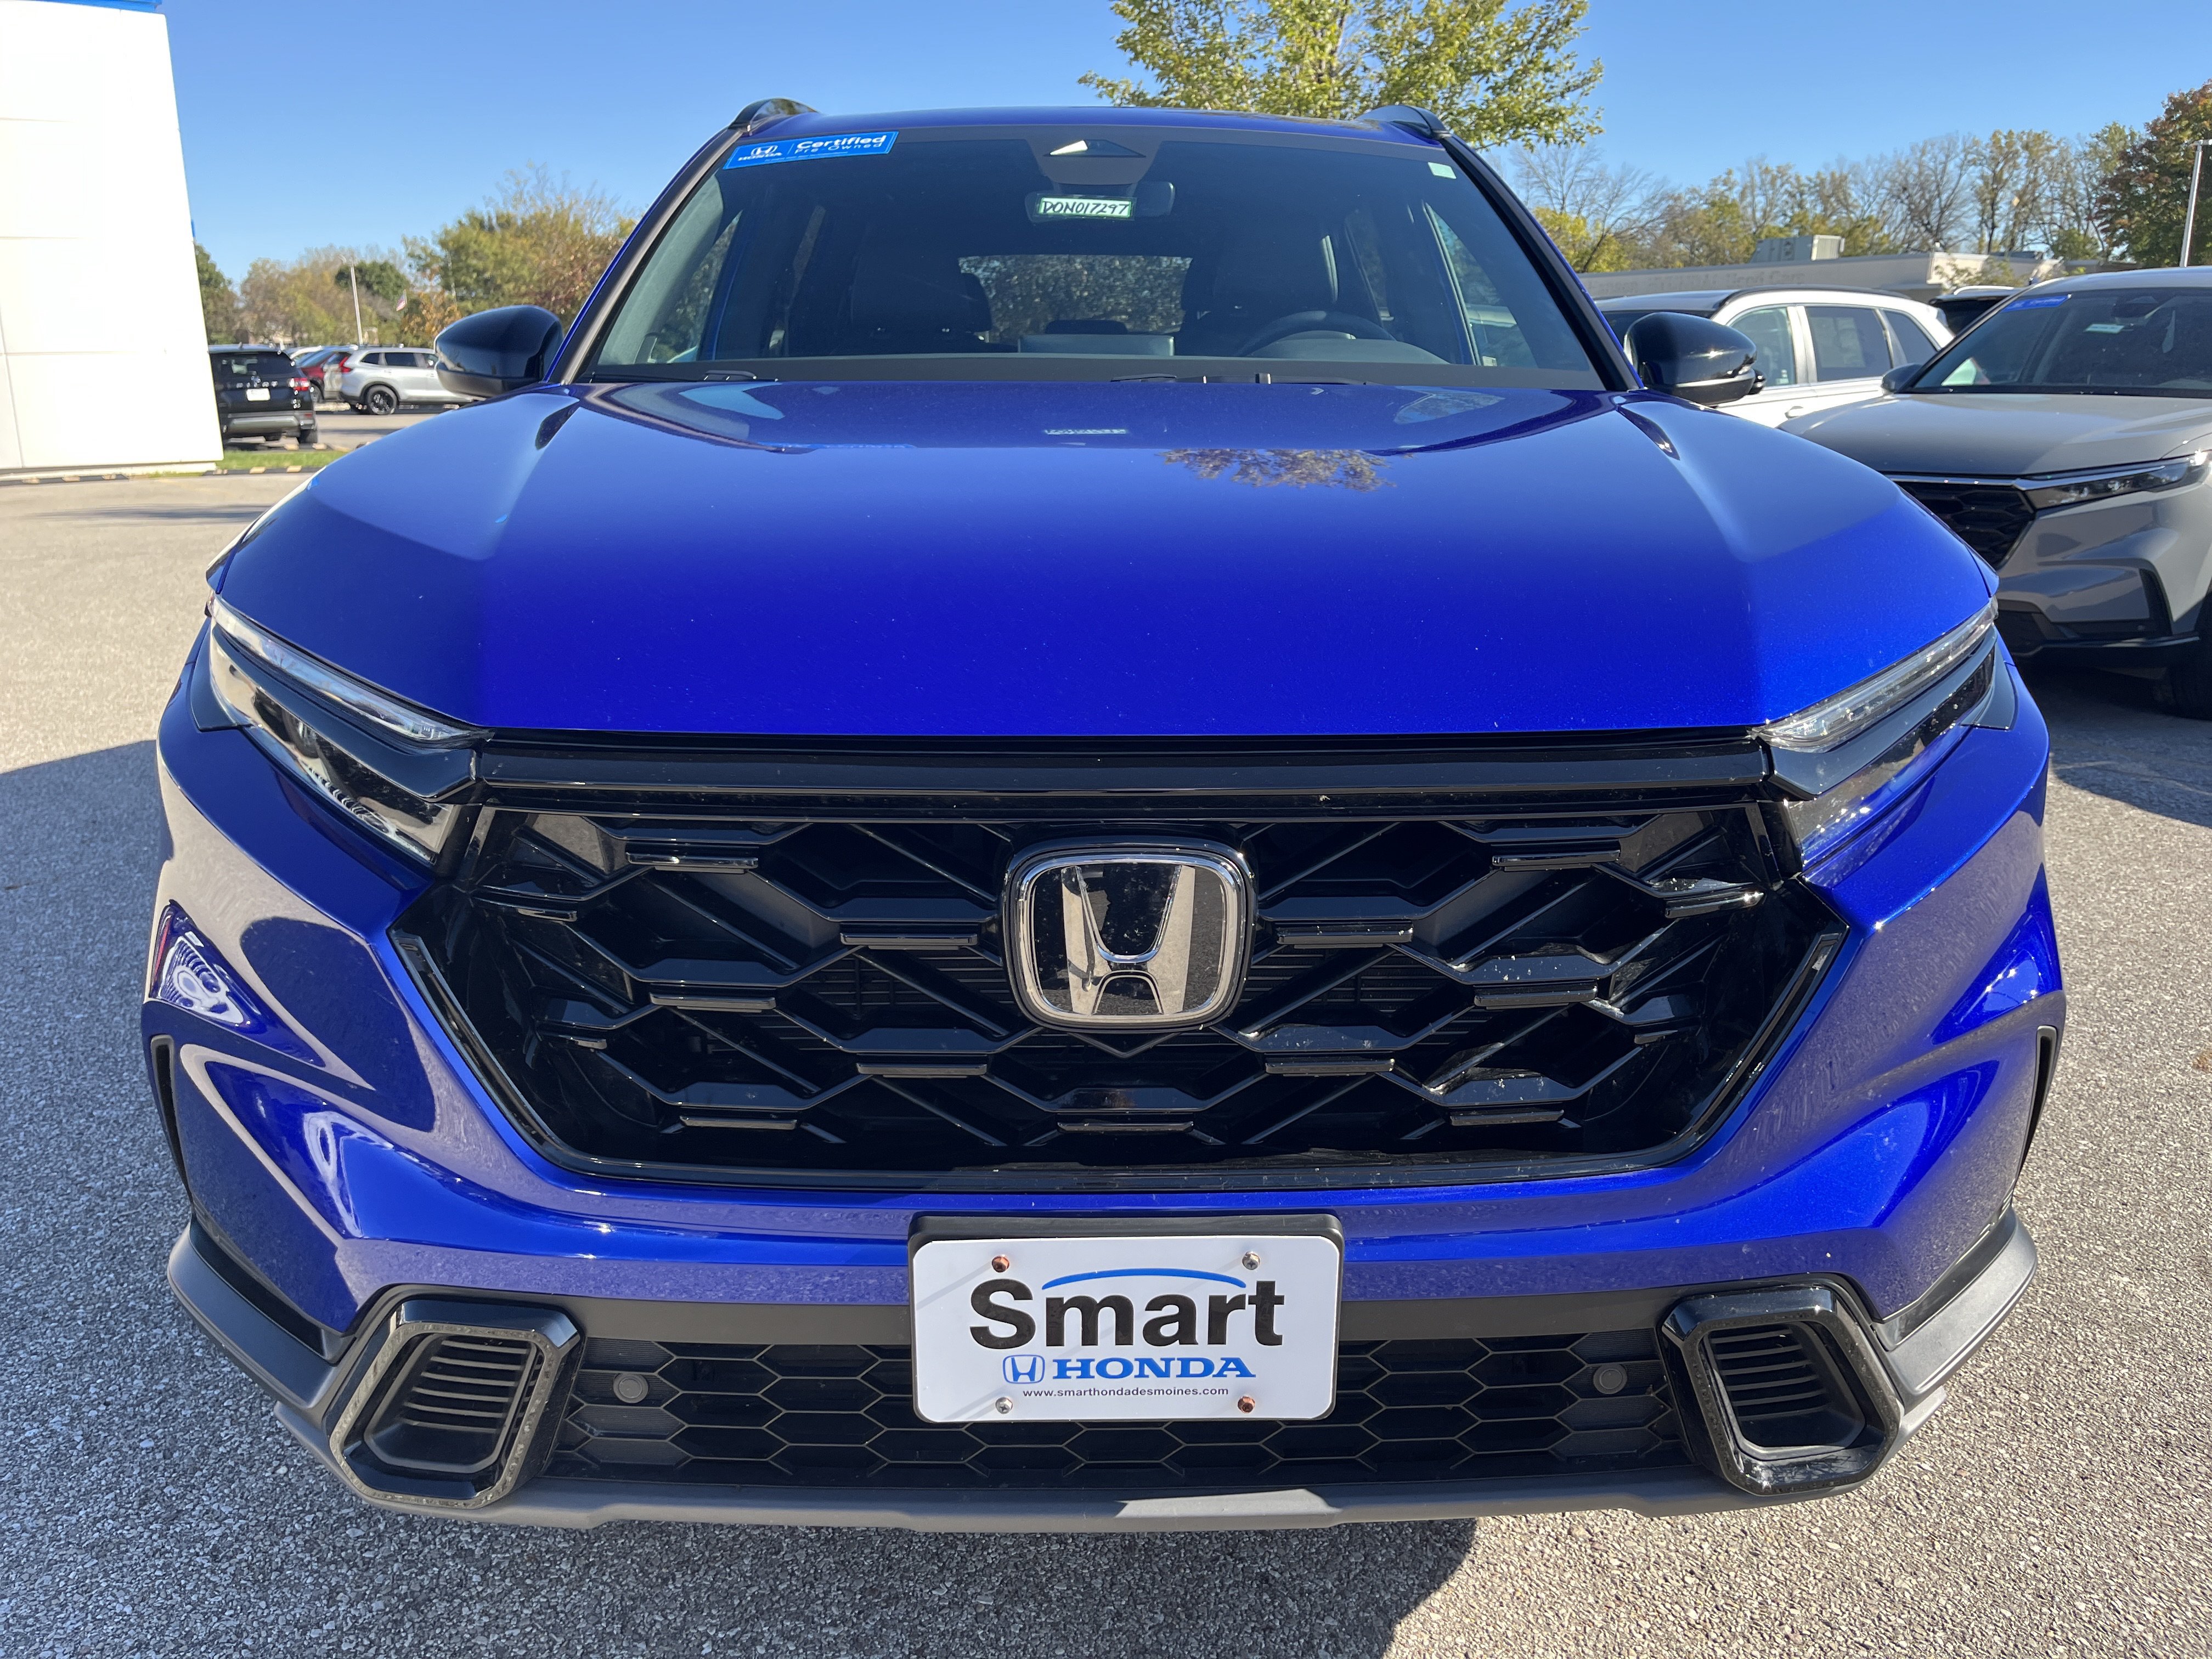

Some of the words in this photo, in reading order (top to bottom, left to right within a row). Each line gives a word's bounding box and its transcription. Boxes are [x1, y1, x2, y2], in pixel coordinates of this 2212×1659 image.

[797, 135, 887, 149] Certified
[969, 1279, 1284, 1350] Smart
[1052, 1357, 1256, 1379] HONDA
[1023, 1387, 1229, 1396] www.smarthondadesmoines.com
